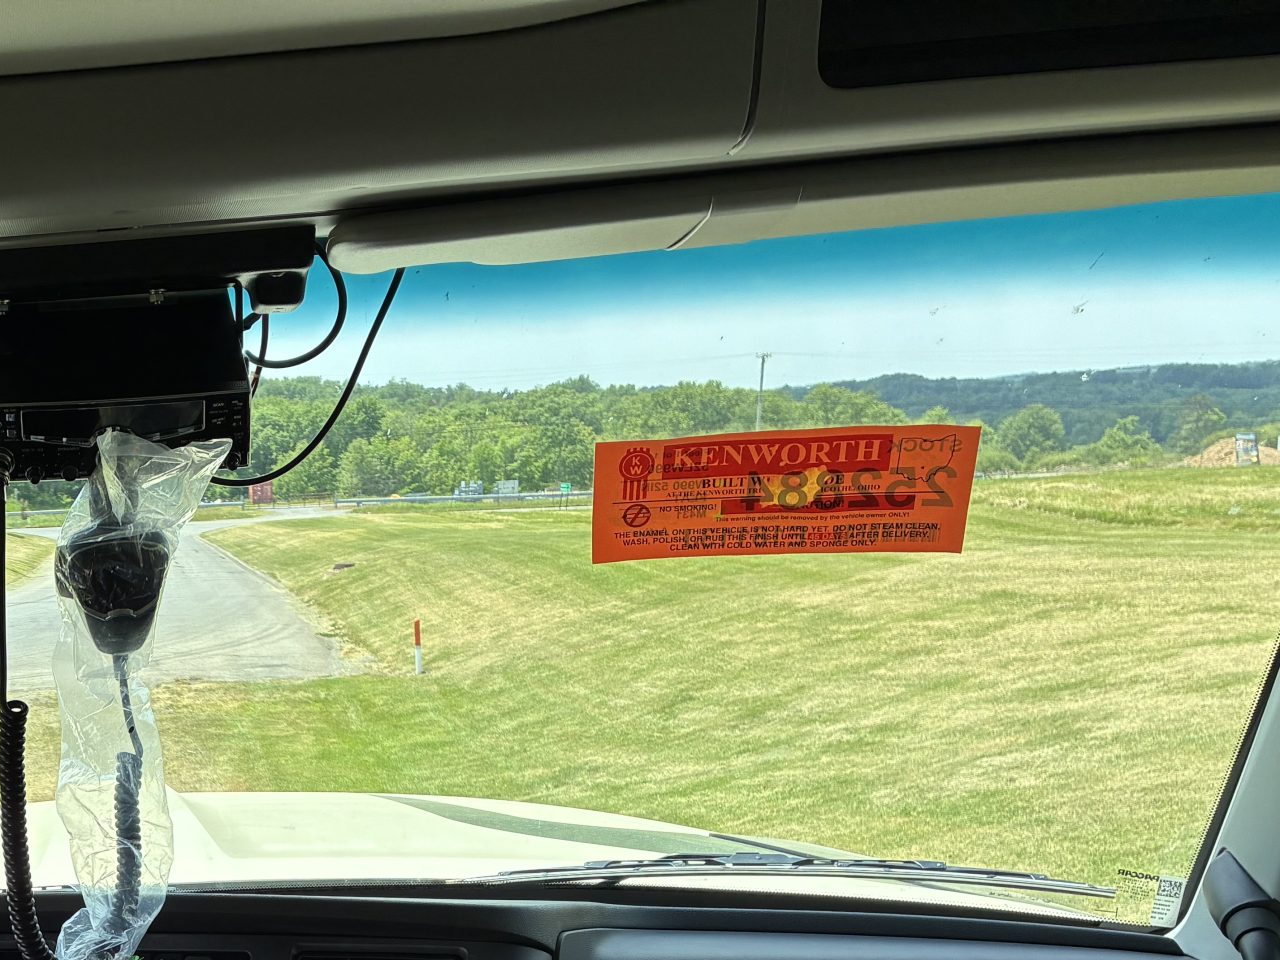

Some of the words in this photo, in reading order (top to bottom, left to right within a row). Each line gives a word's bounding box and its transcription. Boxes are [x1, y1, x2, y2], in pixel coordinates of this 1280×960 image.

[670, 438, 884, 470] KENWORTH
[701, 477, 746, 488] BUILT
[633, 529, 669, 537] ENAMEL
[709, 526, 748, 534] VEHICLE
[870, 522, 903, 530] STEAM
[904, 521, 941, 530] CLEAN.
[781, 532, 806, 540] UNTIL
[848, 531, 878, 539] AFTER
[881, 529, 930, 539] DELIVERY.
[669, 543, 699, 551] CLEAN
[753, 540, 785, 548] WATER
